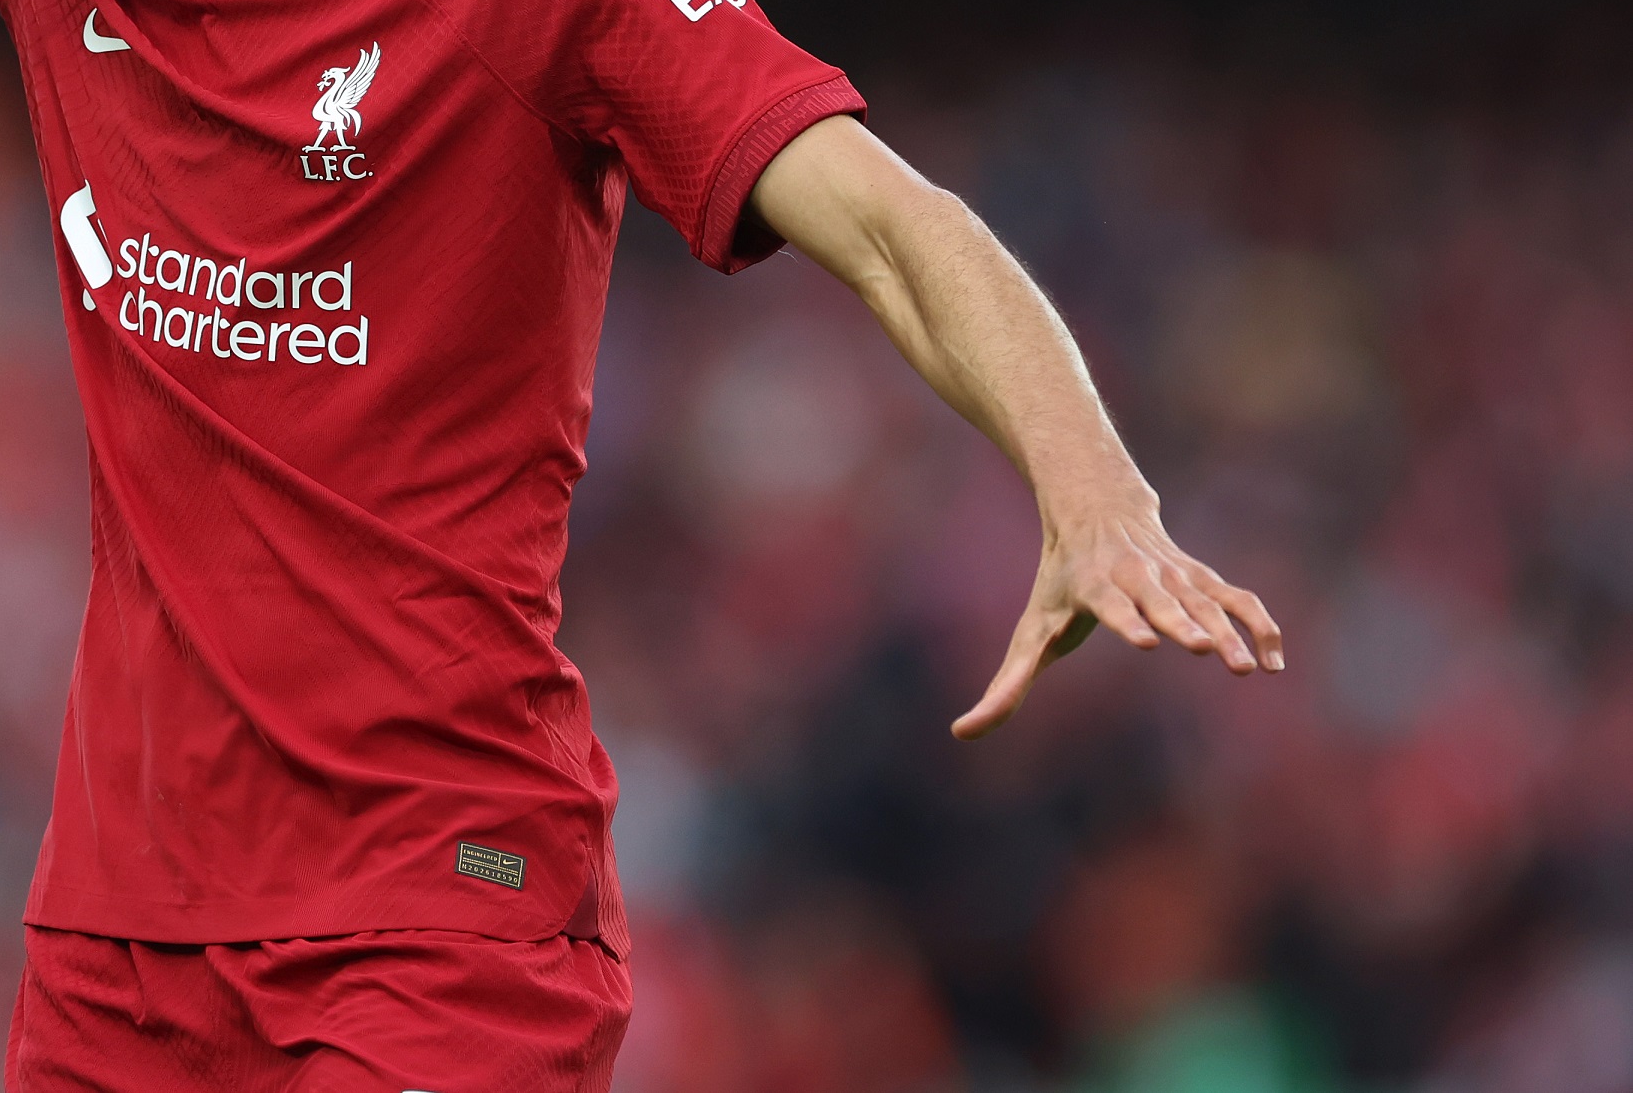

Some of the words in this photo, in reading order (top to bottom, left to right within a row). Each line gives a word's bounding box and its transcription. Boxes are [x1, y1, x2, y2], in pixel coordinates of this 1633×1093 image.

[299, 153, 374, 181] L.F.C.
[116, 232, 352, 311] standard
[119, 288, 368, 365] chartered
